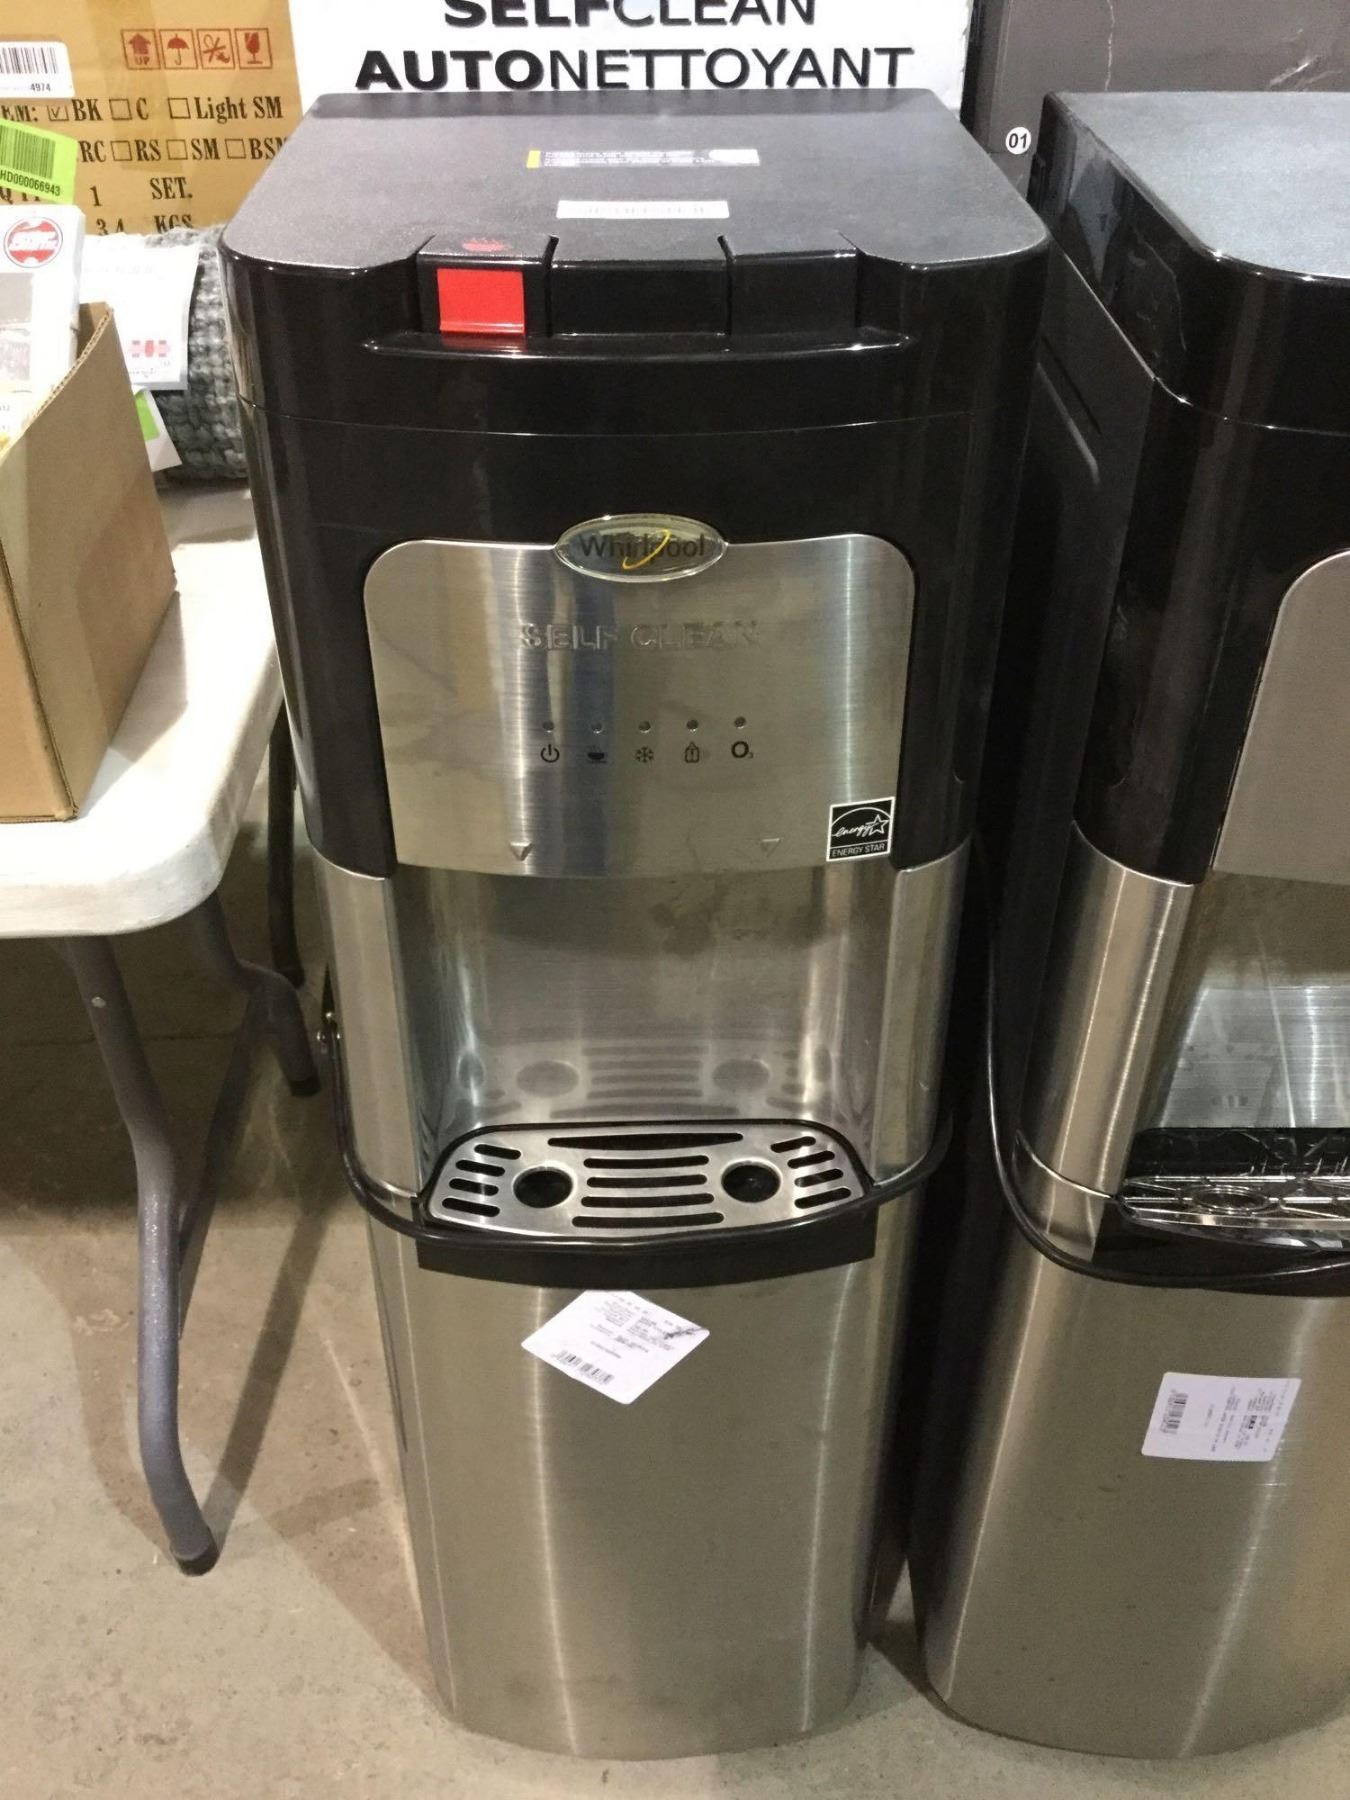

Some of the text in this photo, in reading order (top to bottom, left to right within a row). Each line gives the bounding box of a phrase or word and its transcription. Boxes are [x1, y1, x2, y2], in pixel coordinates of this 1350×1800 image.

[444, 0, 815, 27] SELFCLEAN
[355, 47, 915, 90] AUTONETTOYANT
[30, 83, 51, 91] 4974
[71, 98, 102, 121] BK
[136, 99, 149, 121] C
[194, 96, 248, 125] Light
[252, 95, 283, 119] SM
[78, 140, 107, 163] RC
[137, 139, 161, 162] RS
[190, 137, 220, 160] SM
[1008, 132, 1028, 149] 01
[150, 176, 193, 200] SET.
[579, 531, 706, 562] Whirlpool
[831, 842, 886, 857] ENERGY STAR
